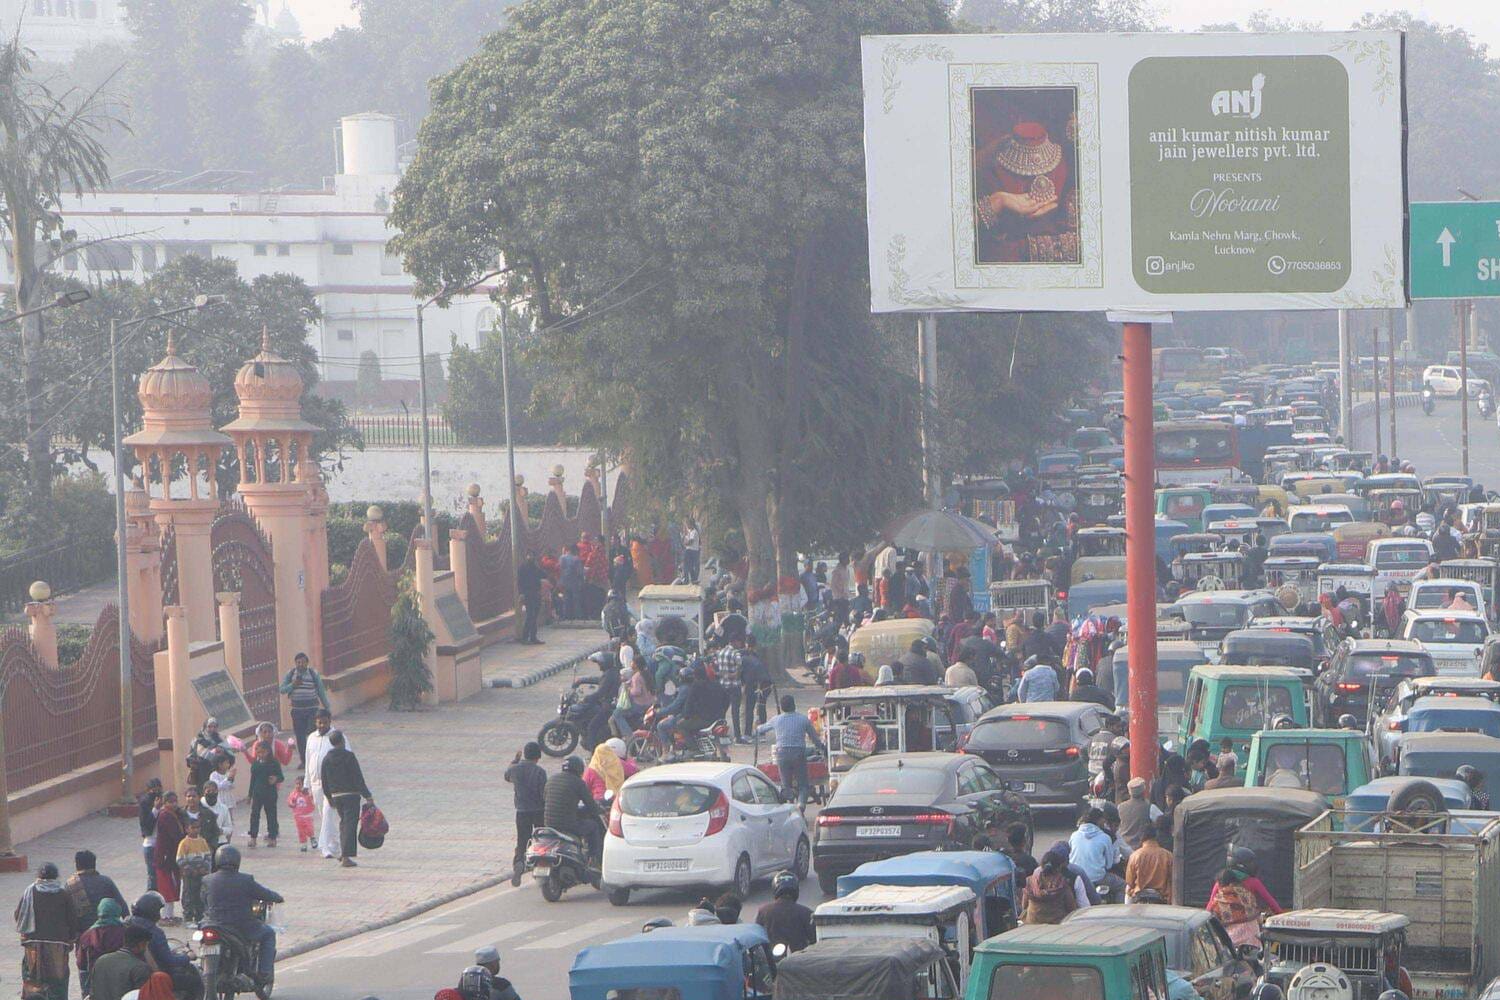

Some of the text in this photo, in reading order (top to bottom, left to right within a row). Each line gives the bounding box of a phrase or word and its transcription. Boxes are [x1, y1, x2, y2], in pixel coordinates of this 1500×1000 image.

[1149, 126, 1330, 143] anil kumar nitish kumar
[1158, 143, 1320, 162] jain jewellers pvt. ltd.
[1213, 173, 1262, 182] PRESENTS
[1190, 187, 1281, 218] Noorani
[1168, 229, 1300, 242] Kamla Nehru Marg, Chowk,
[1214, 244, 1256, 255] Lucknow
